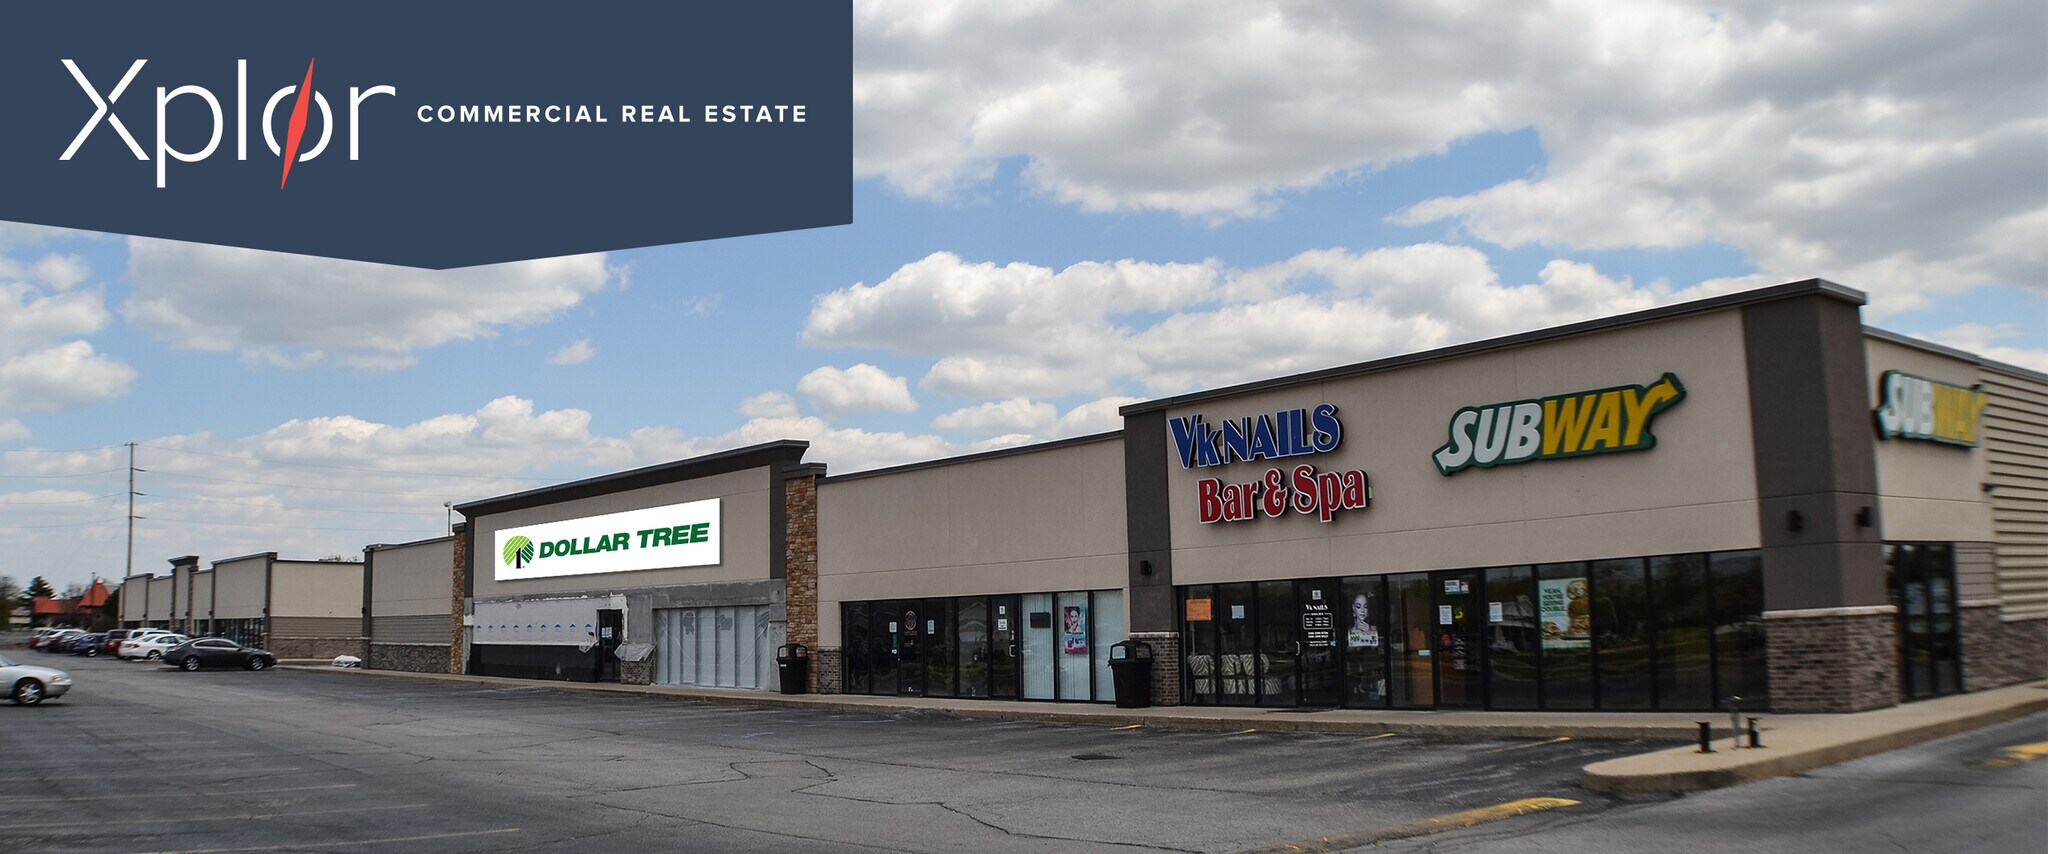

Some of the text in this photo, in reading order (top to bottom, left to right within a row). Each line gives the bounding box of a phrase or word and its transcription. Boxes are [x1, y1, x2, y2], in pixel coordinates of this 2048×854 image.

[1434, 378, 1680, 471] SUBWAY
[1879, 373, 1987, 444] SUBWAY
[1197, 463, 1368, 524] Bar & Spa
[539, 522, 710, 559] DOLLAR TREE
